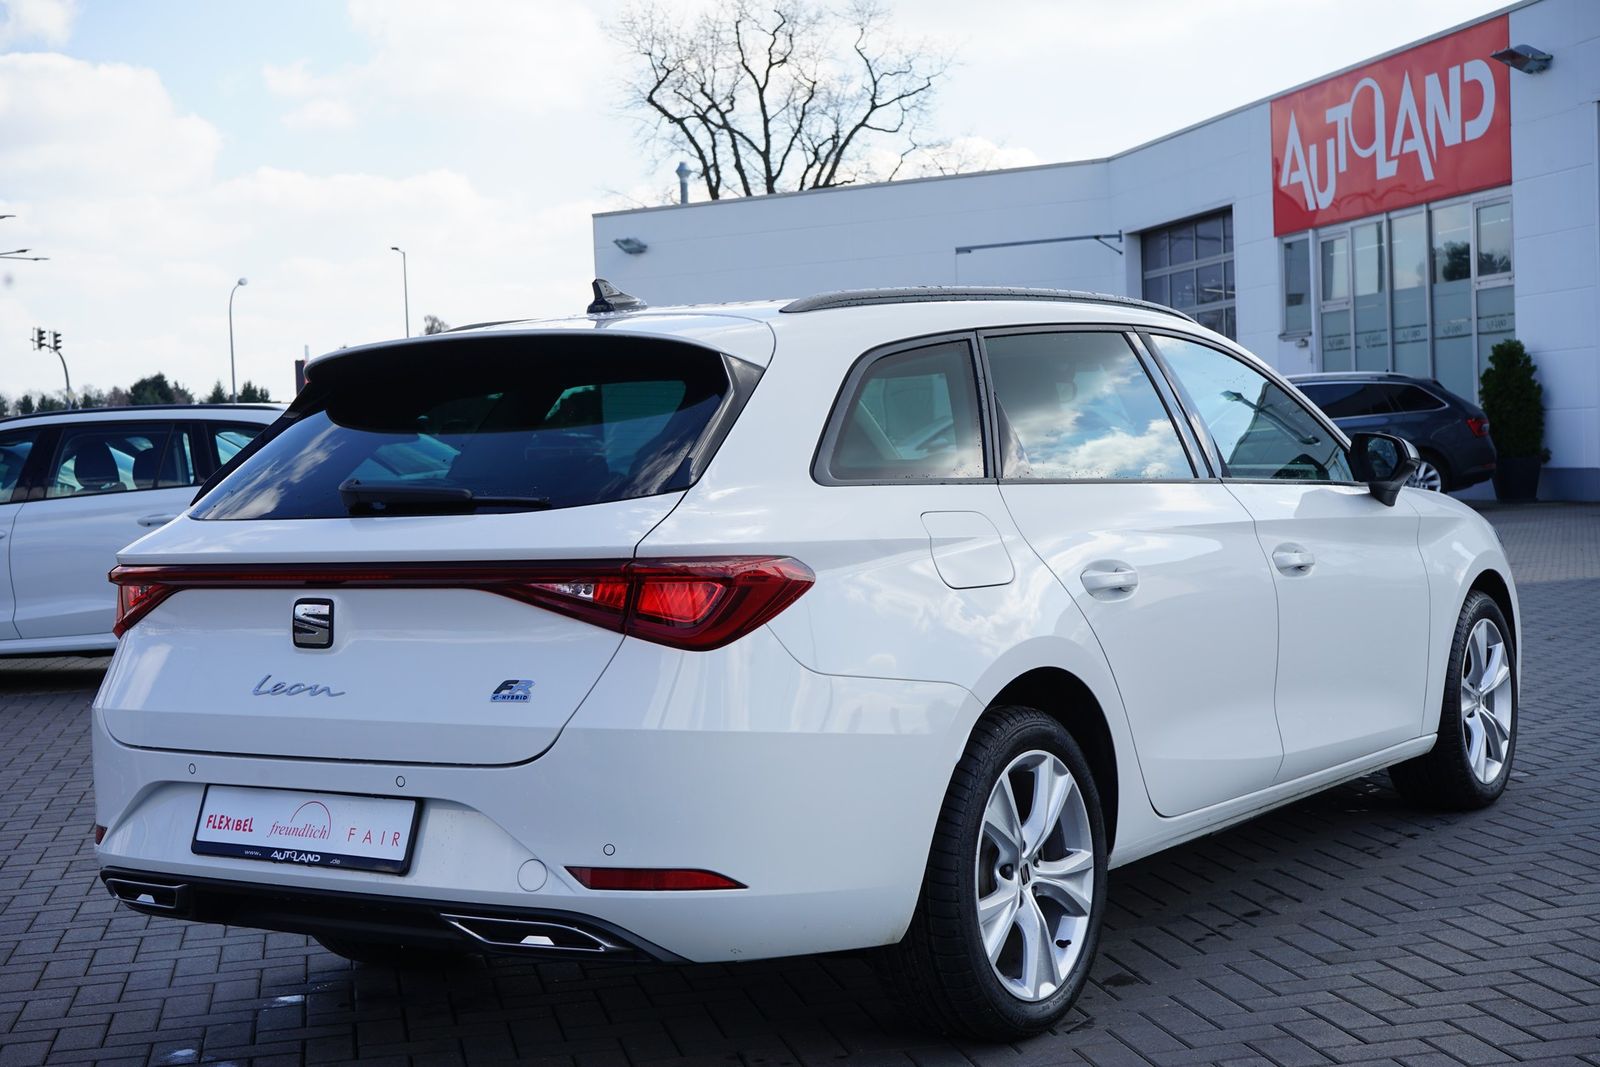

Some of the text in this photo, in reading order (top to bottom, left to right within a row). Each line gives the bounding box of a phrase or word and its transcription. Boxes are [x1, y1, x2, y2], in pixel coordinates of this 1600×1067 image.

[1281, 59, 1496, 211] AUTOLAND
[252, 674, 346, 698] Leon
[492, 679, 536, 695] FR
[206, 814, 254, 833] FLEXIBEL
[266, 821, 328, 840] freundlich
[270, 850, 321, 863] AUTOLAND
